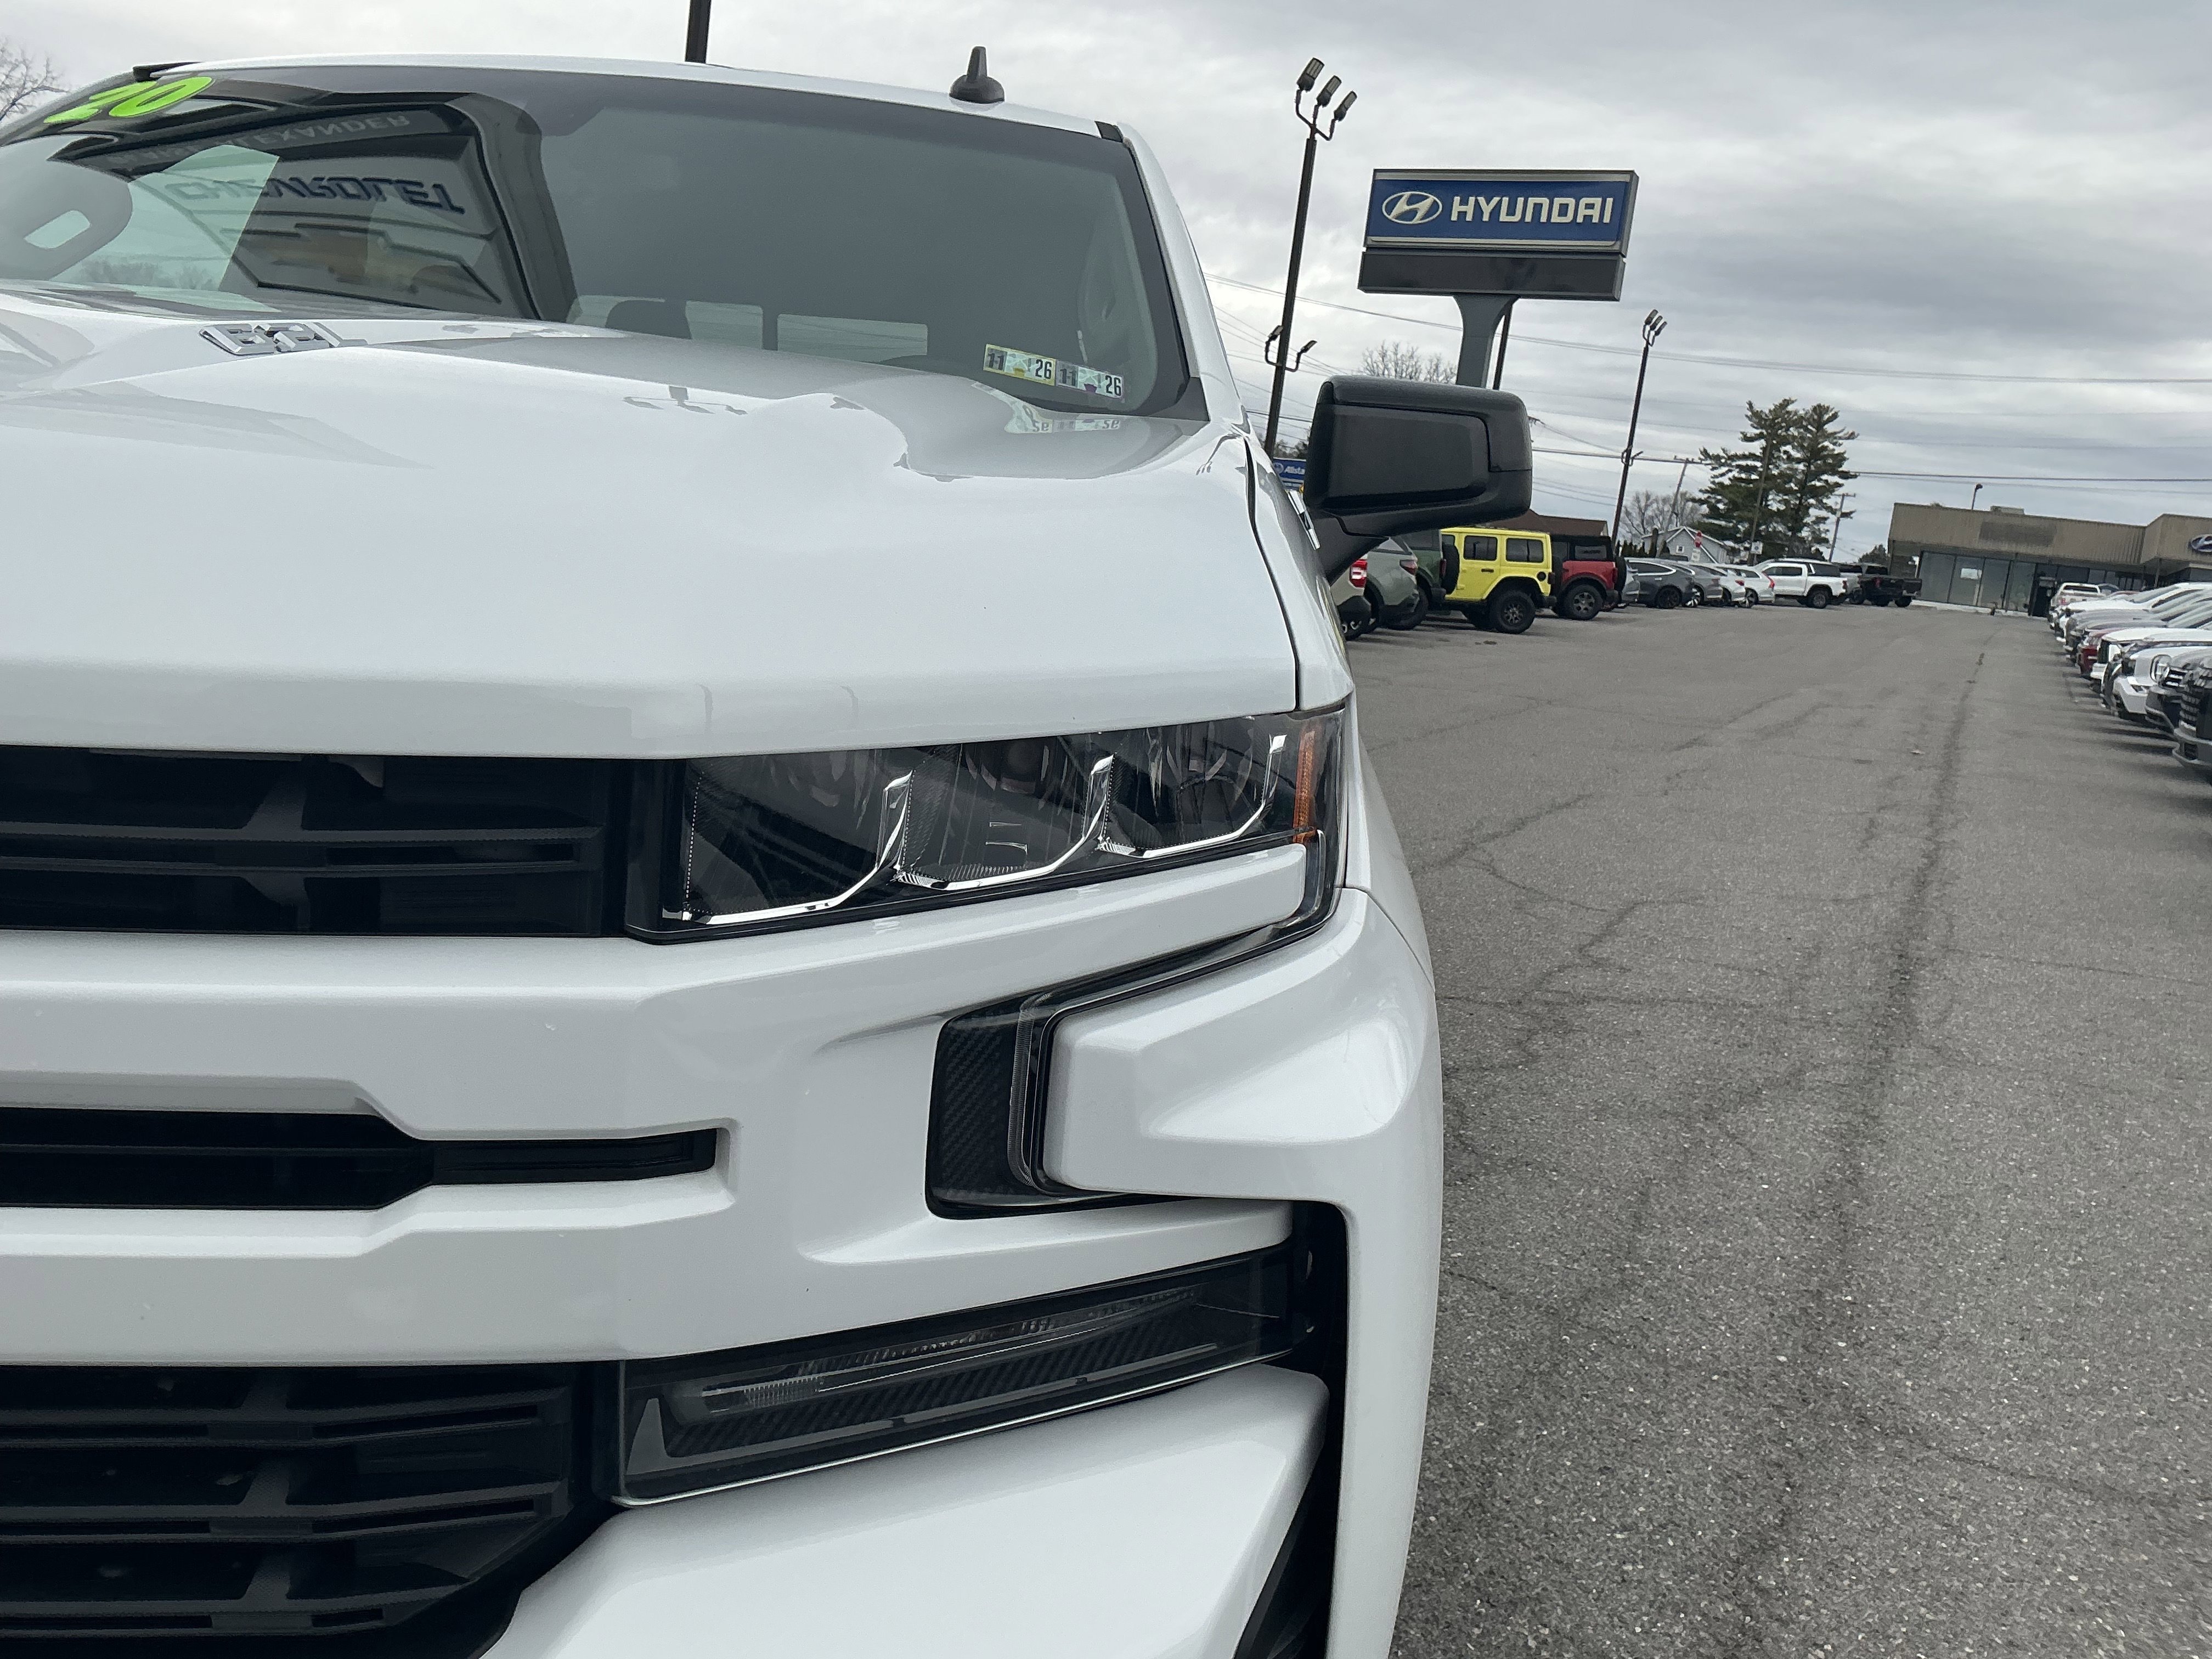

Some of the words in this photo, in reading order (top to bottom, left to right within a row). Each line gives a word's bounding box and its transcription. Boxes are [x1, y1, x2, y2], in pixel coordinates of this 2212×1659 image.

[43, 76, 213, 123] 20
[1451, 196, 1613, 223] HYUNDAI
[988, 353, 1004, 370] 11
[1035, 359, 1052, 380] 26
[1059, 368, 1078, 386] 11
[1104, 375, 1121, 396] 26
[1284, 466, 1306, 475] Allsta
